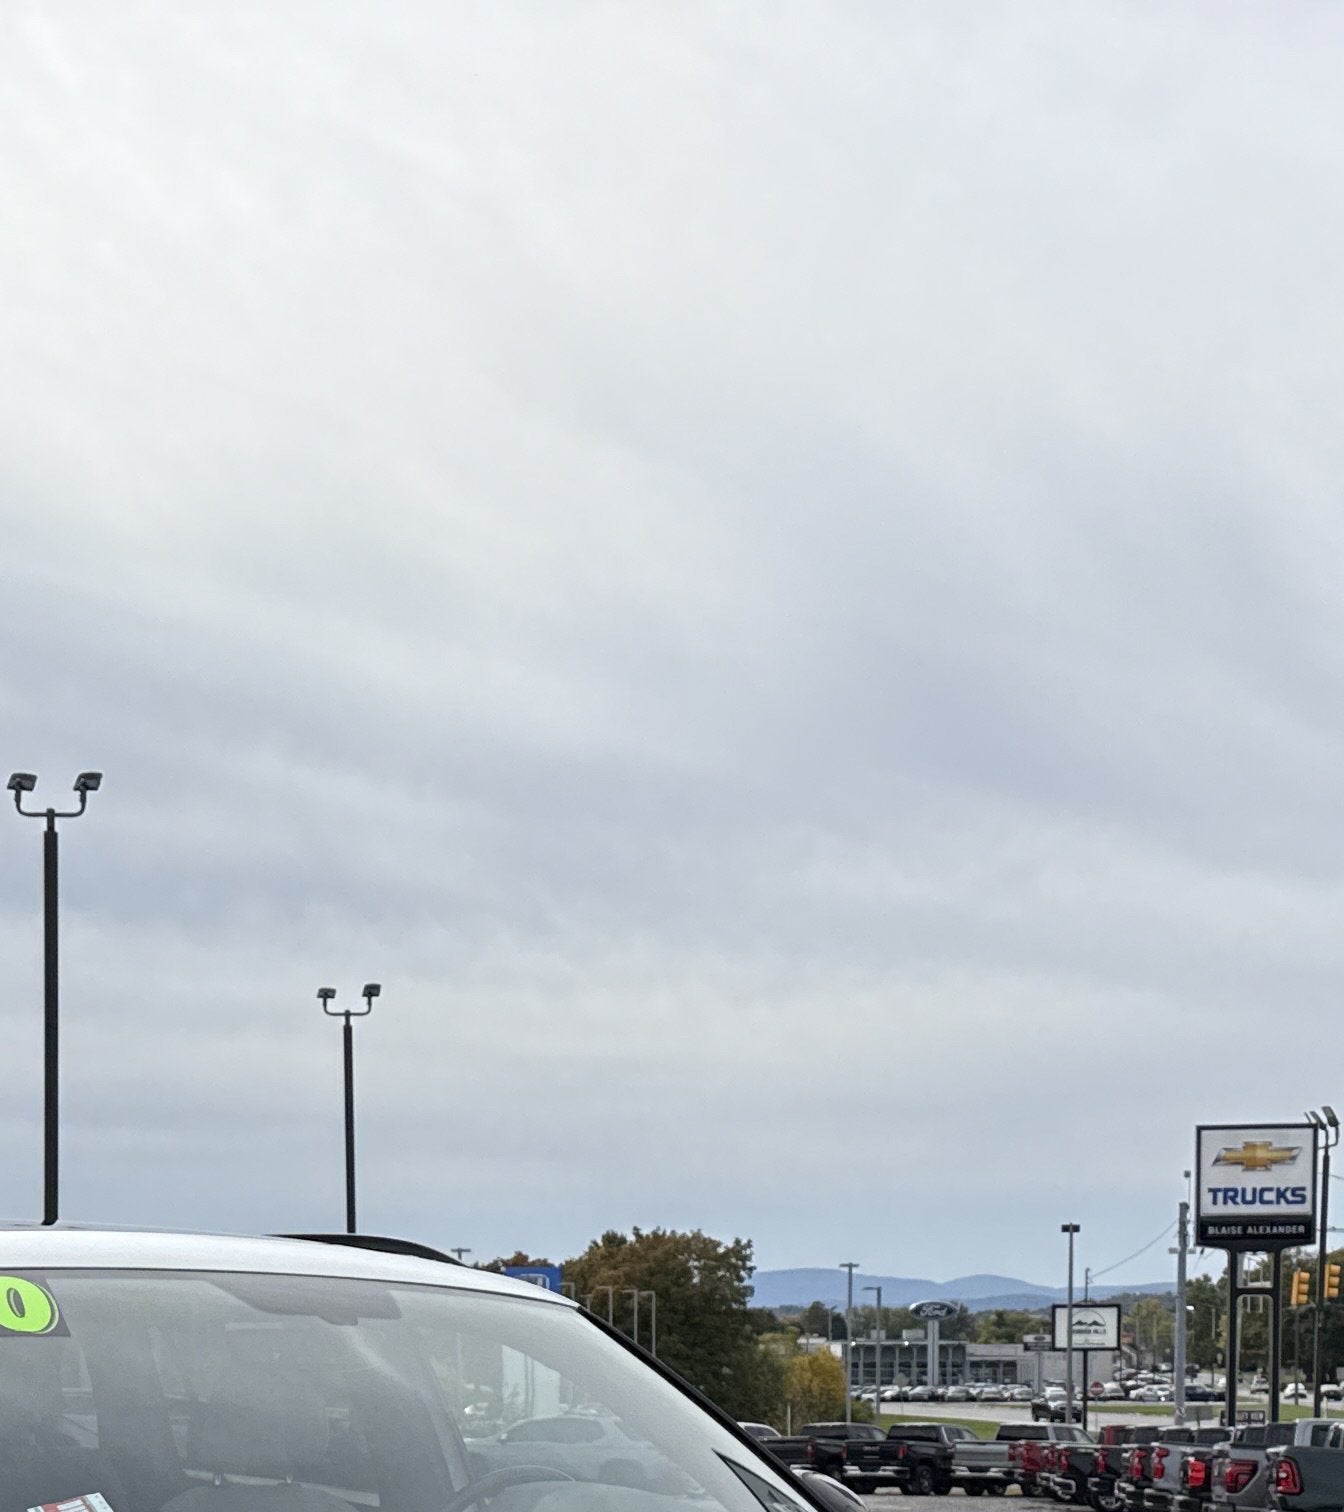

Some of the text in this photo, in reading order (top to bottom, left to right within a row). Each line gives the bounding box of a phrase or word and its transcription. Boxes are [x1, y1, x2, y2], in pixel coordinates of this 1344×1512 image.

[1207, 1186, 1307, 1206] TRUCKS
[1207, 1224, 1305, 1235] BLAISE ALEXANDER
